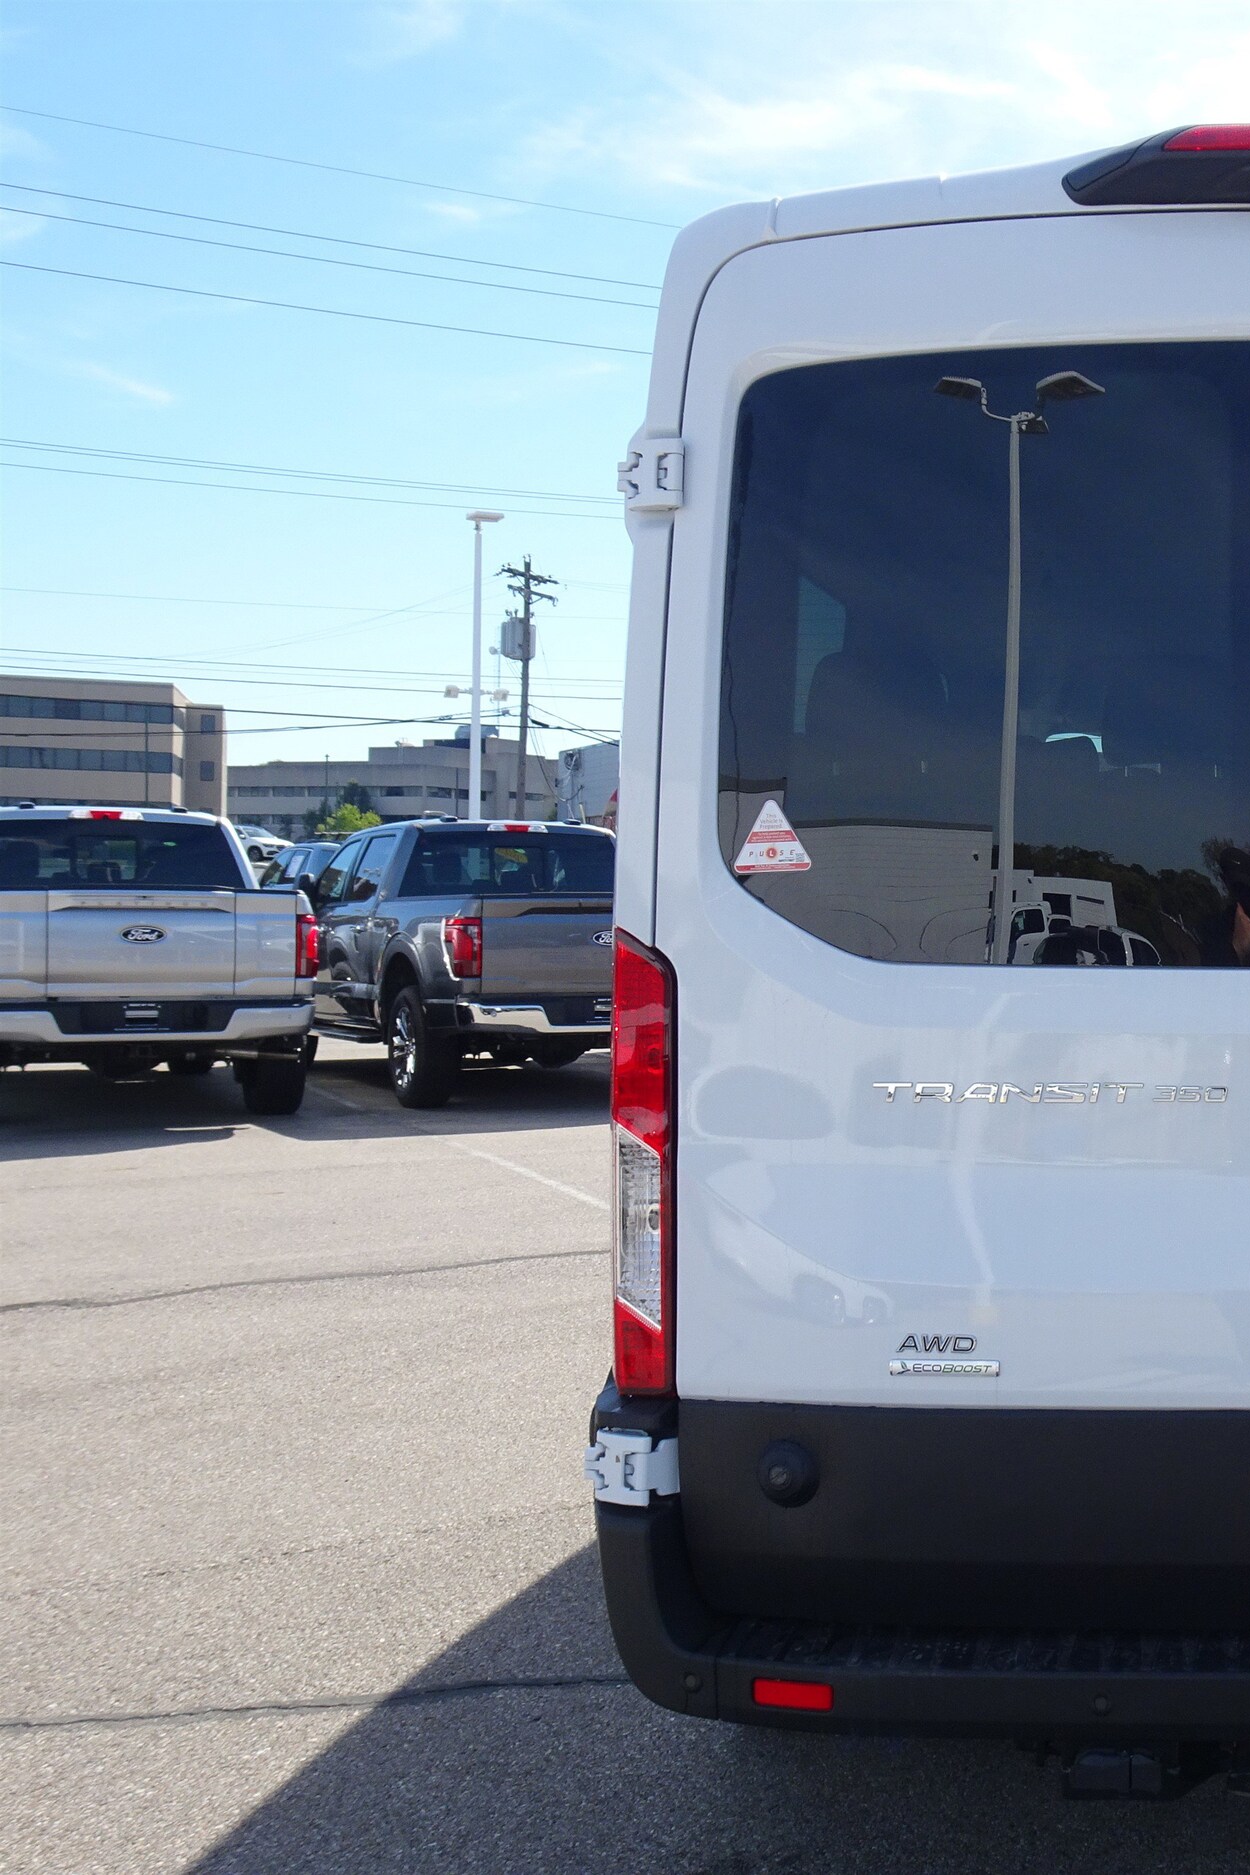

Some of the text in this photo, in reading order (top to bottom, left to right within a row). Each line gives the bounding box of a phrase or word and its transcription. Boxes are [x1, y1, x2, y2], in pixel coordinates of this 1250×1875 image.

[748, 847, 796, 857] PULSE
[127, 928, 159, 942] Ford
[872, 1081, 1229, 1103] TRANSIT 350
[896, 1333, 977, 1353] AWD
[912, 1363, 993, 1373] ECOBOOST
